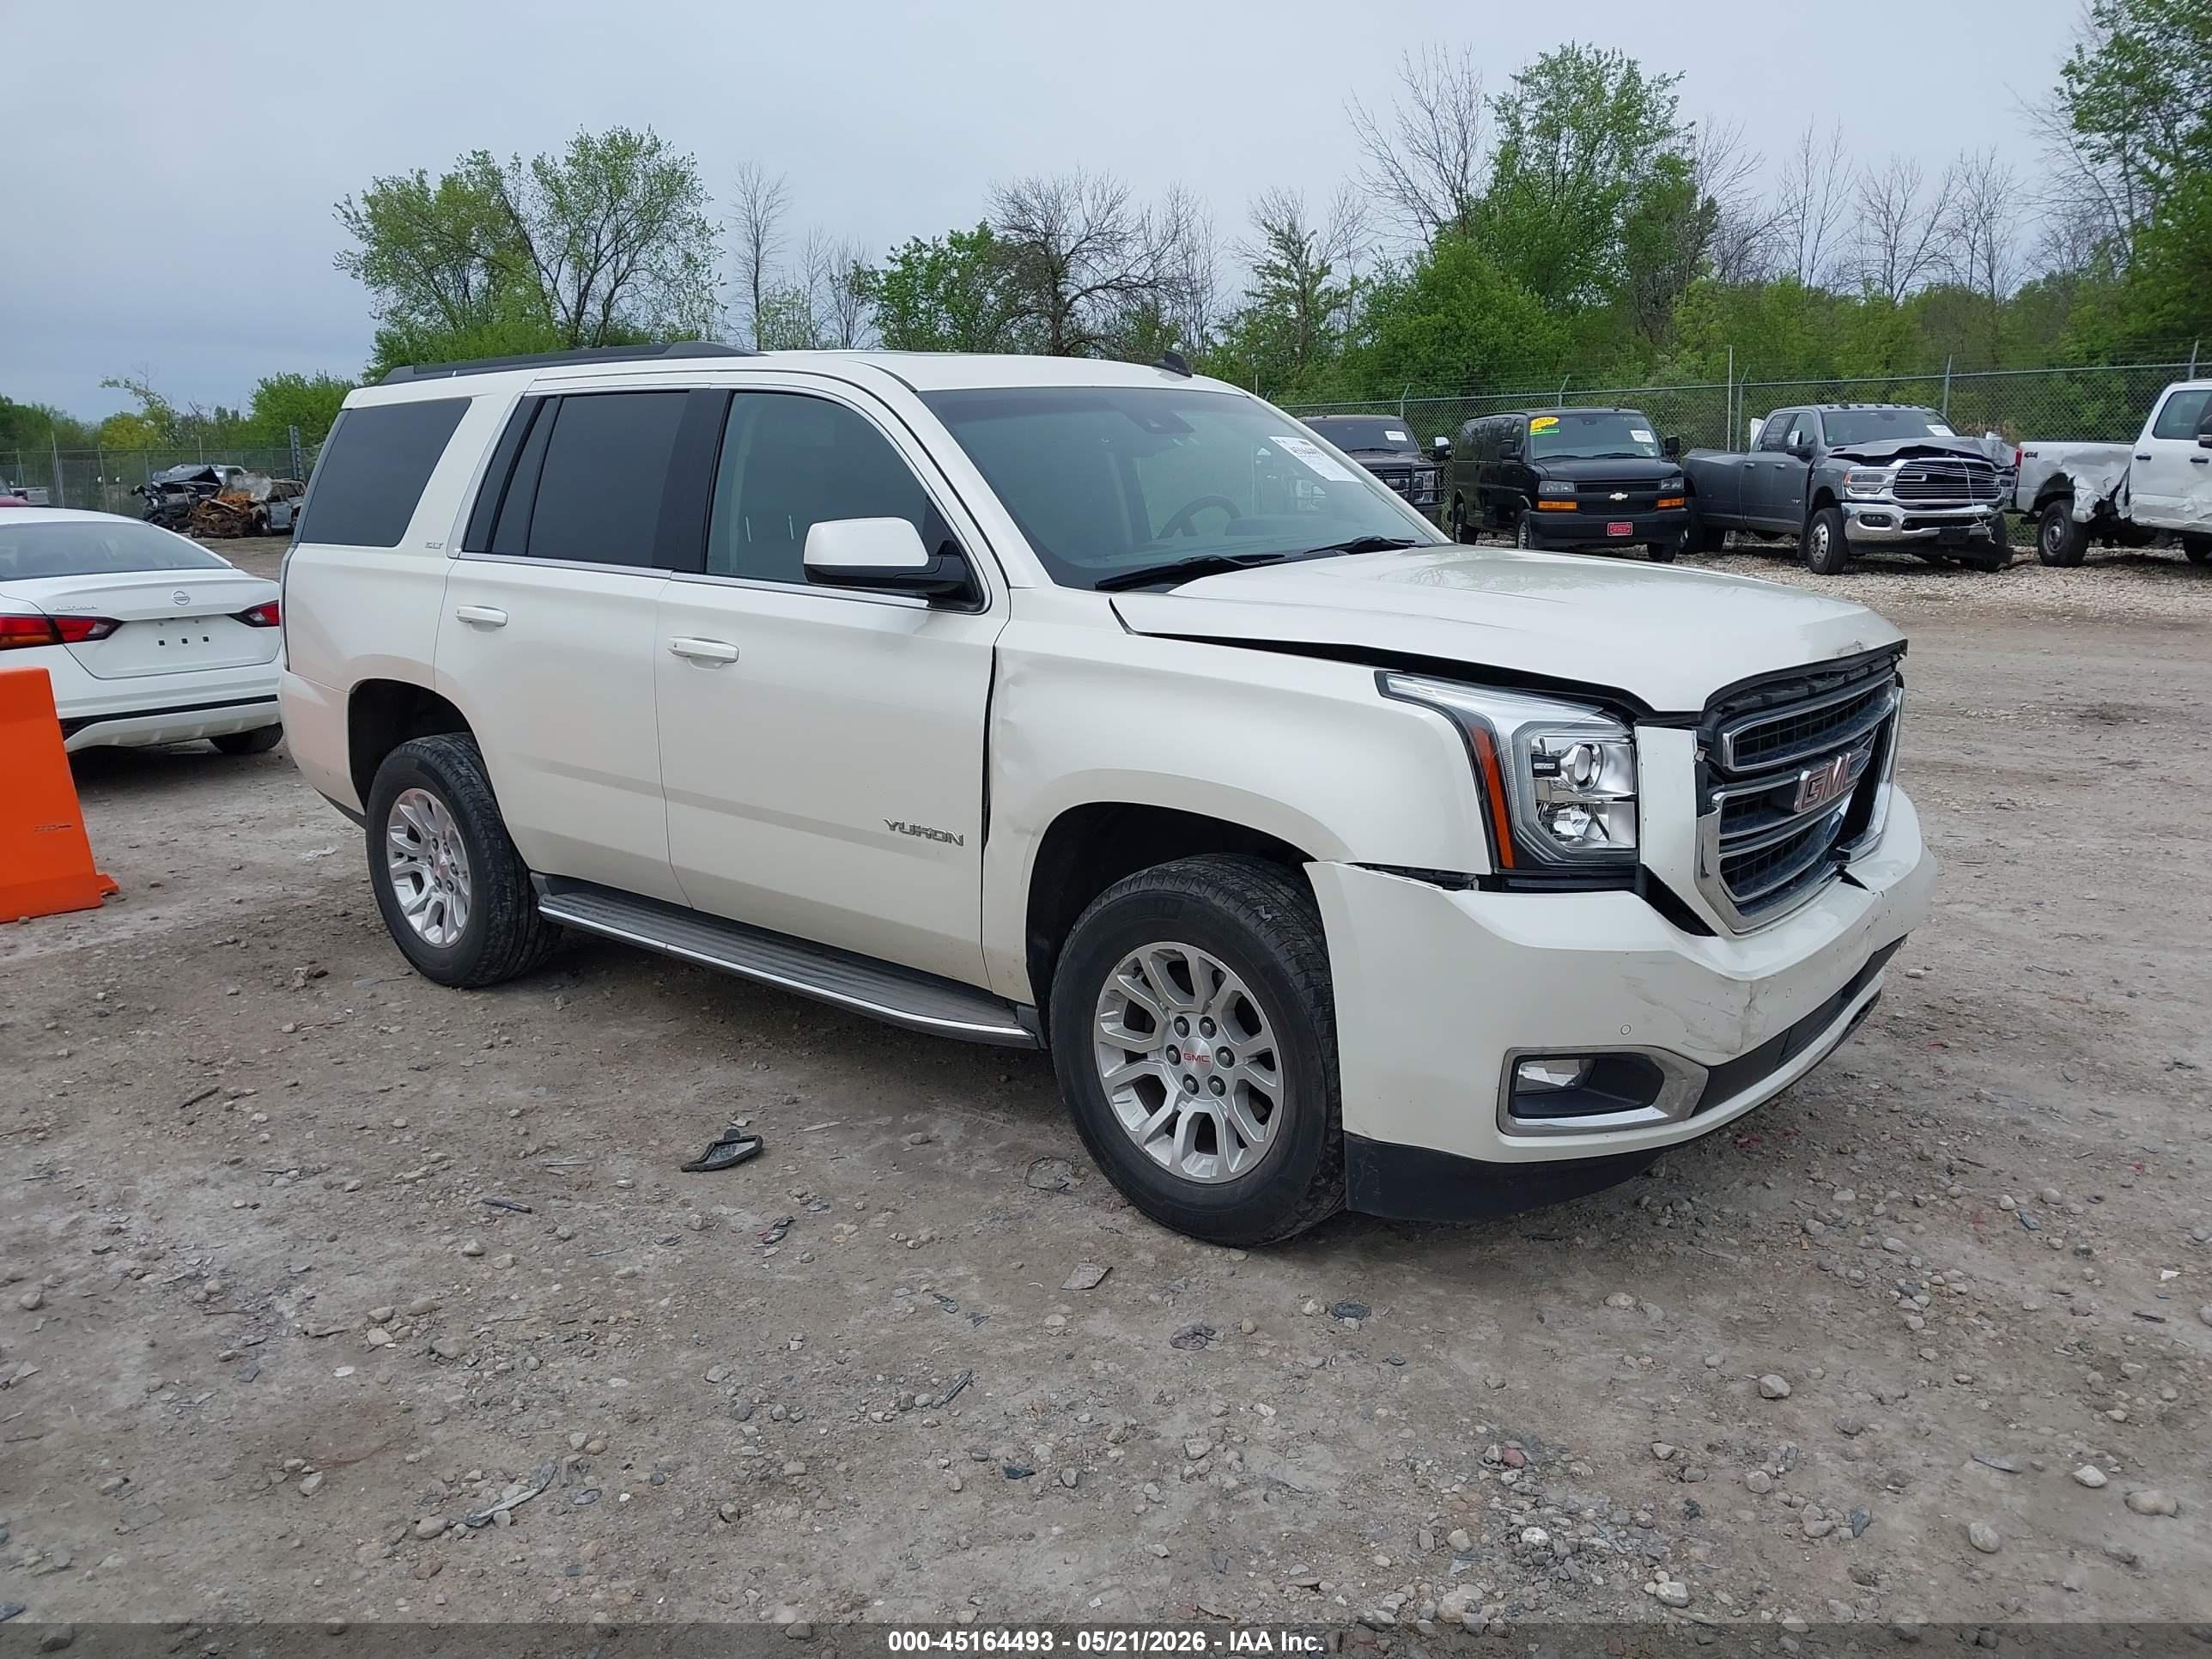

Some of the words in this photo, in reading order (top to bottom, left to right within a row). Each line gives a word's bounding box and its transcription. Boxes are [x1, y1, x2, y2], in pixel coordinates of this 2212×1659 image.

[1793, 749, 1871, 813] GMC
[881, 817, 964, 847] YUKON
[1183, 1053, 1211, 1063] GMC
